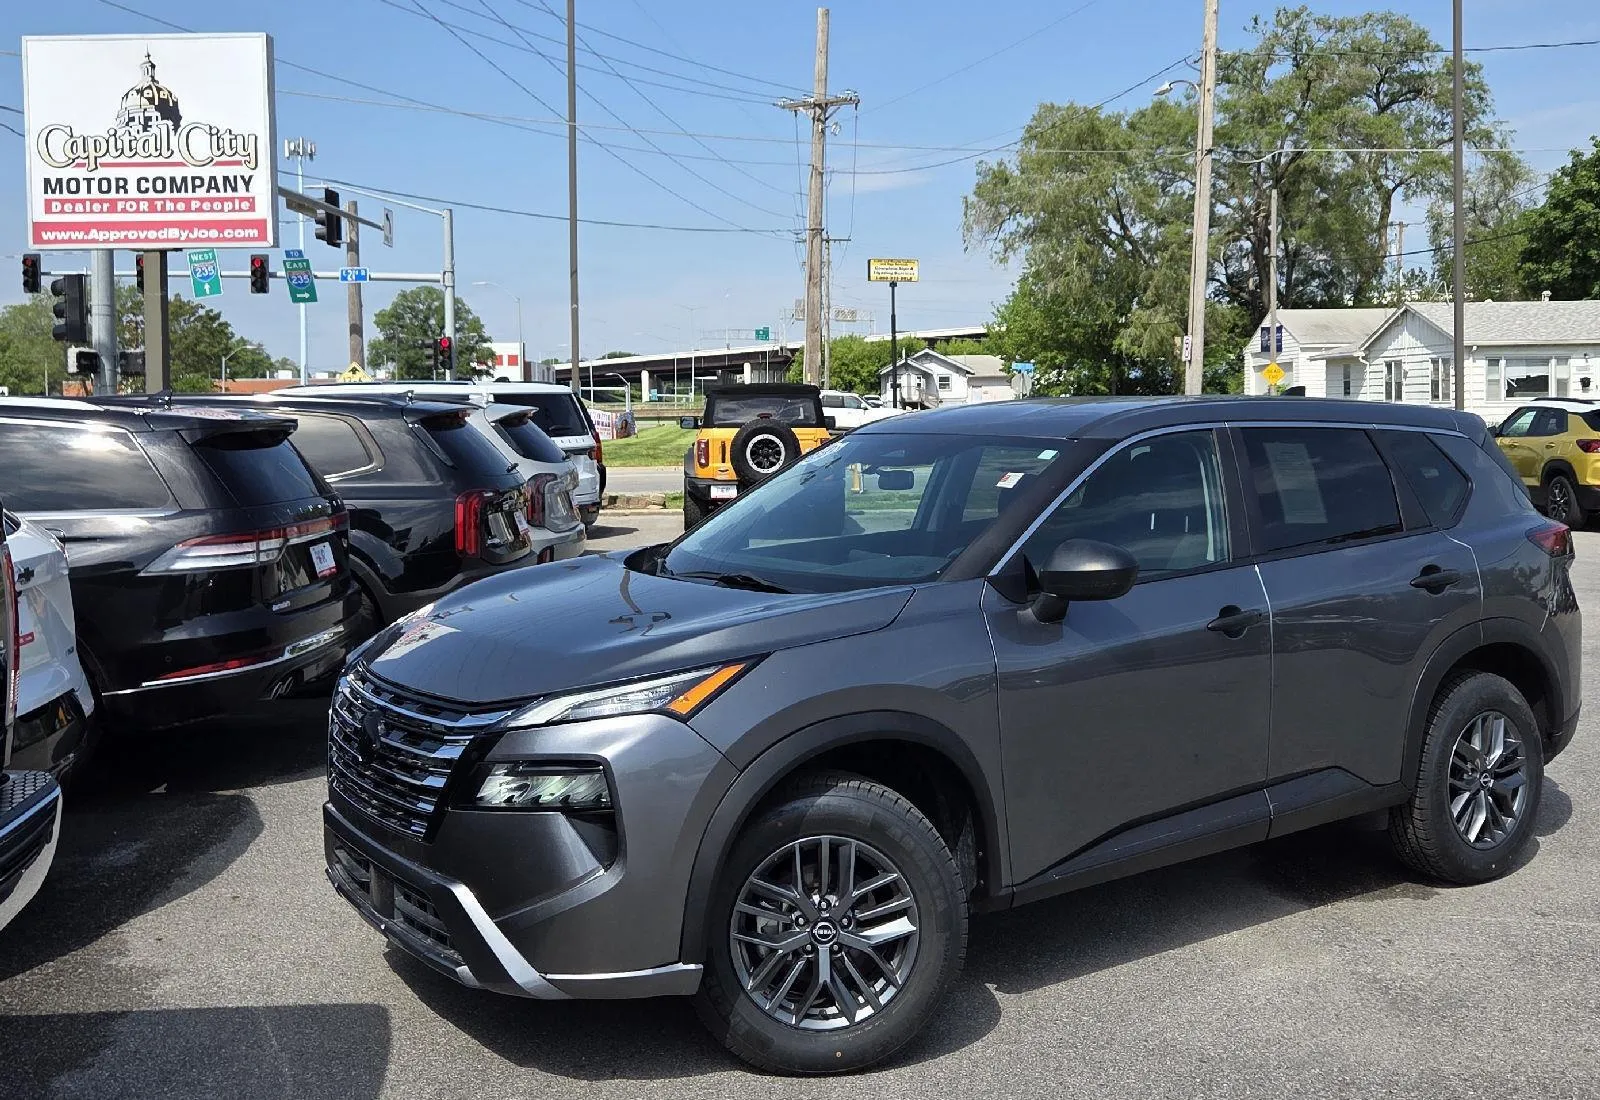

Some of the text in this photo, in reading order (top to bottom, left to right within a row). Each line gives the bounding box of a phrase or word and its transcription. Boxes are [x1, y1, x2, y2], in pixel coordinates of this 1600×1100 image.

[37, 122, 258, 172] Capital City
[43, 175, 254, 194] MOTOR COMPANY
[51, 200, 111, 213] Dealer
[116, 200, 149, 212] FOR
[154, 199, 186, 211] The
[41, 227, 259, 241] www.ApprovedByJoe.com
[190, 252, 213, 262] WEST
[194, 265, 215, 278] 235
[286, 261, 307, 269] EAST
[291, 274, 310, 284] 235
